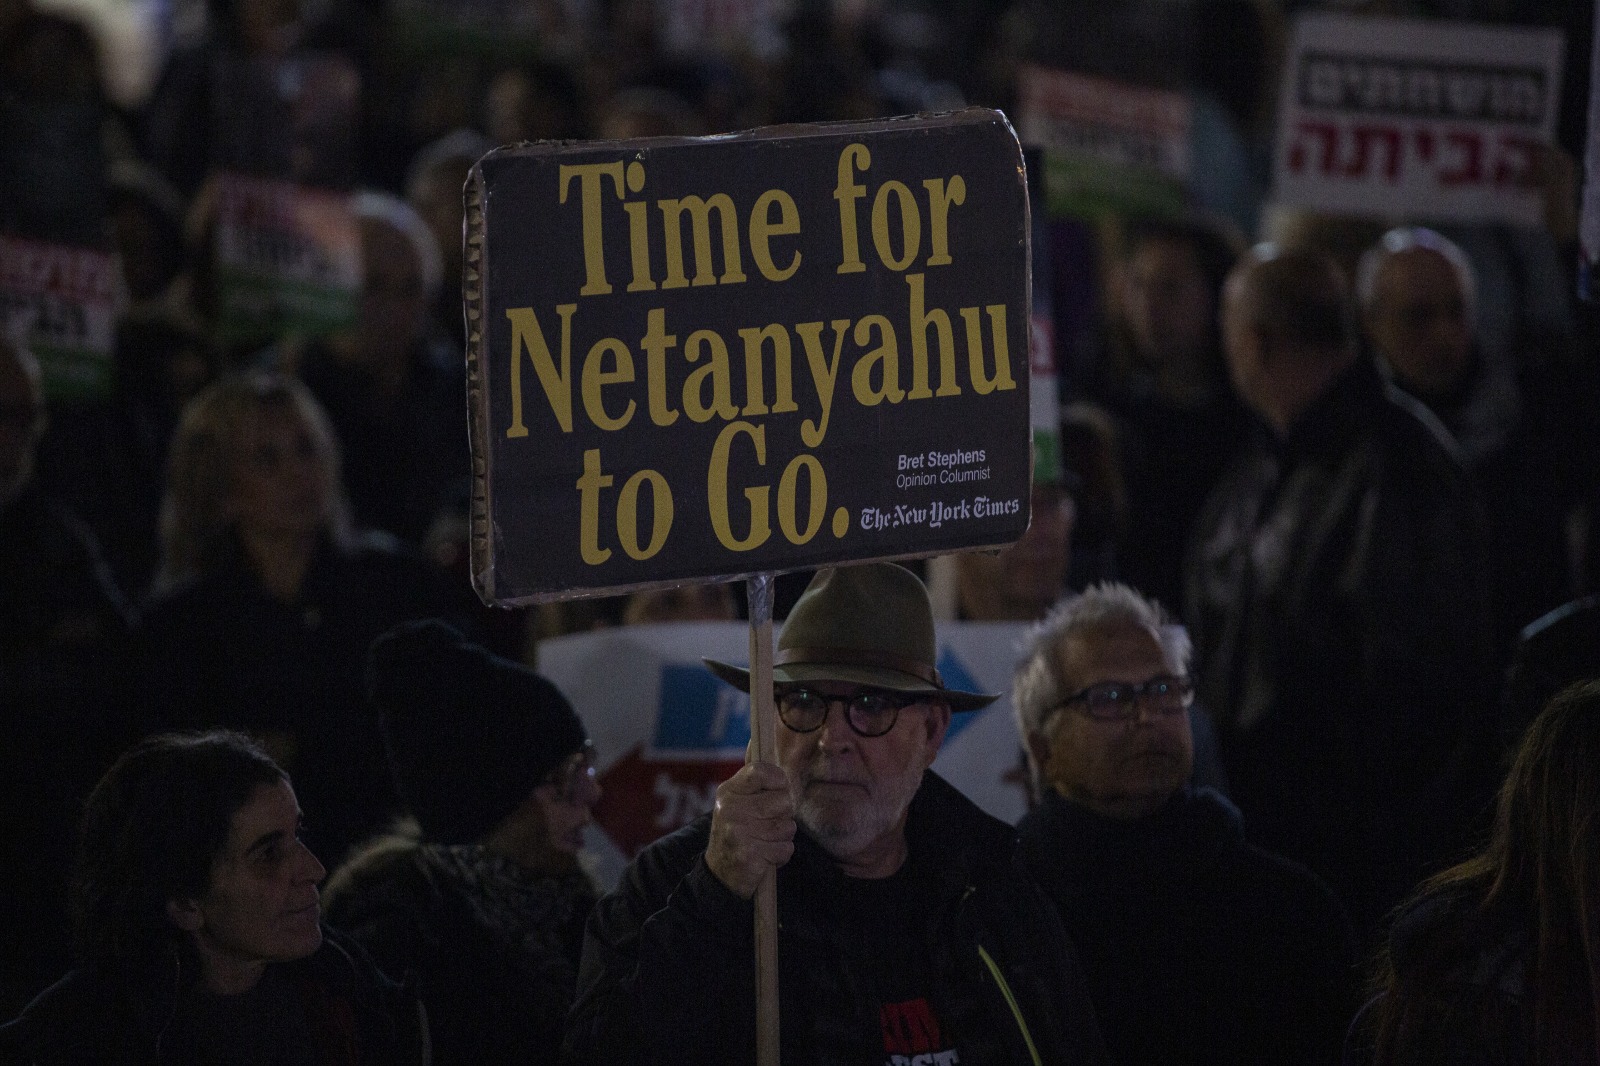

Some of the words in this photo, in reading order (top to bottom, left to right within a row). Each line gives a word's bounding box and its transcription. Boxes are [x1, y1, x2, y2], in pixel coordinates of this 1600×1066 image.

[1288, 121, 1548, 187] הביתה
[560, 162, 801, 295] Time
[834, 144, 966, 274] for
[506, 274, 1017, 447] Netanyahu
[577, 450, 675, 565] to
[707, 421, 849, 552] Go.
[896, 473, 937, 490] Opinion
[939, 466, 991, 483] Columnist
[897, 453, 925, 471] Bret
[927, 449, 986, 468] Stephens
[860, 507, 891, 532] The
[892, 504, 927, 528] New
[929, 499, 971, 528] York
[973, 495, 1020, 518] Times
